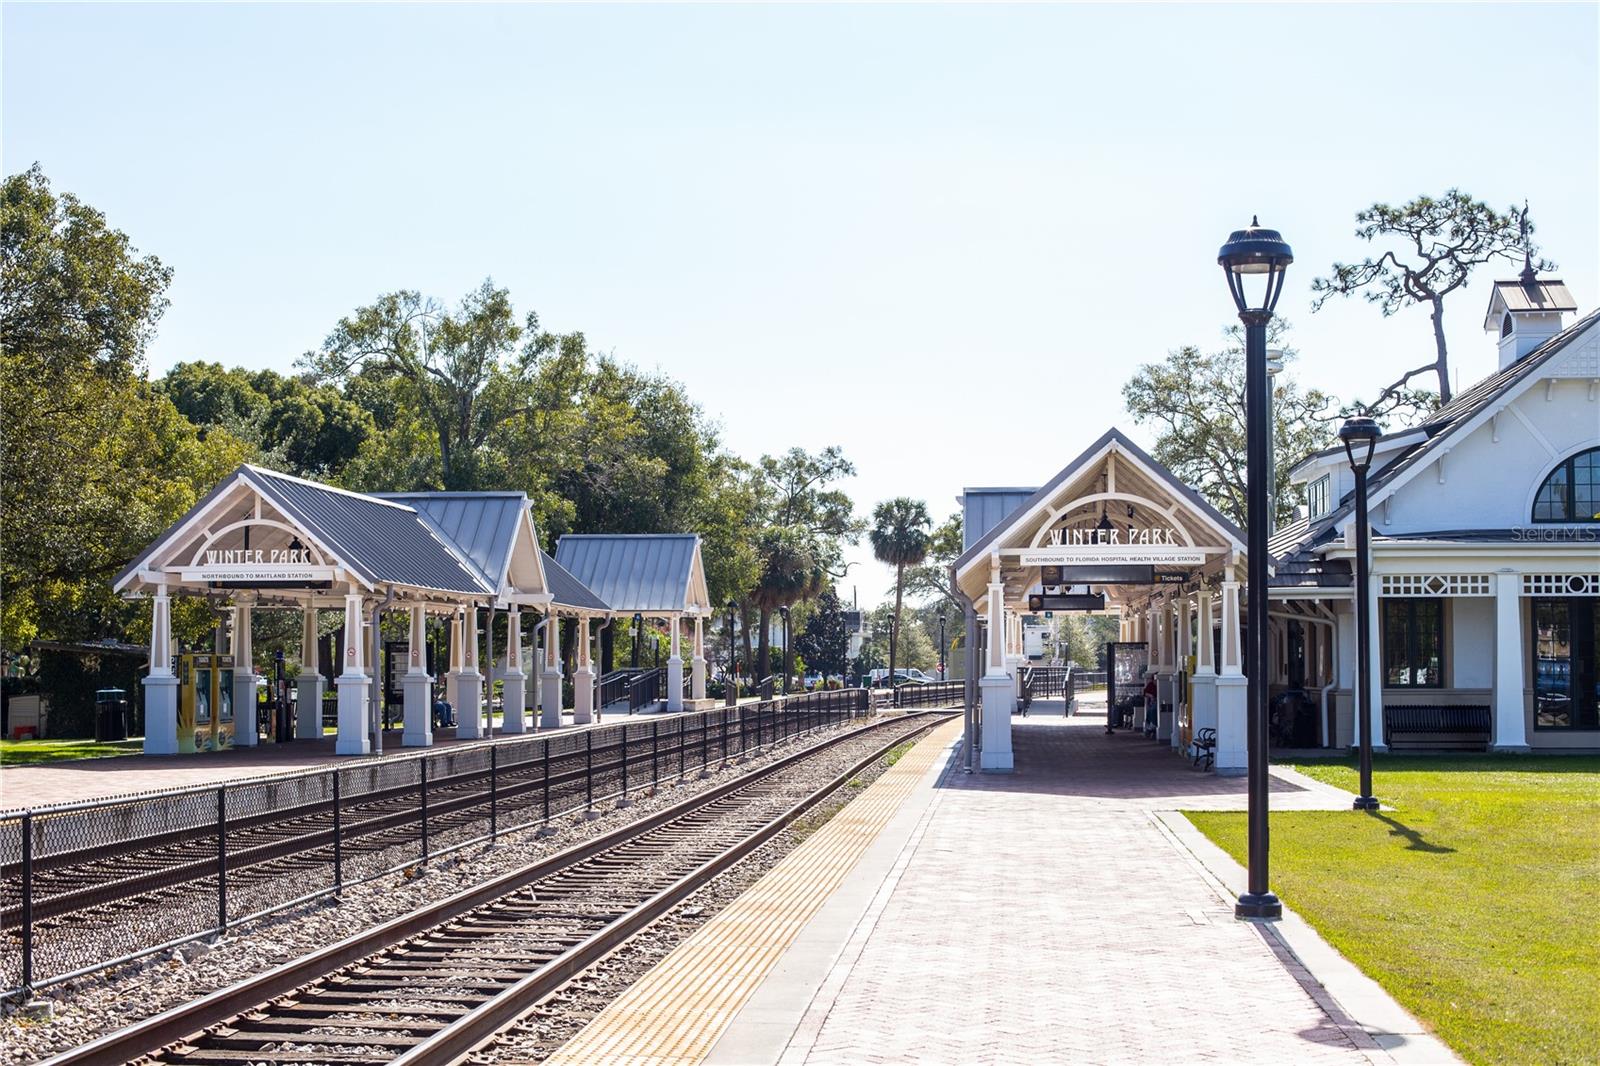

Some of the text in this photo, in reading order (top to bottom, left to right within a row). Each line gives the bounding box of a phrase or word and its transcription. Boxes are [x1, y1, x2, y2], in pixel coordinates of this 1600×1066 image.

[1049, 528, 1176, 545] WINTER PARK
[206, 549, 311, 564] WINTER PARK
